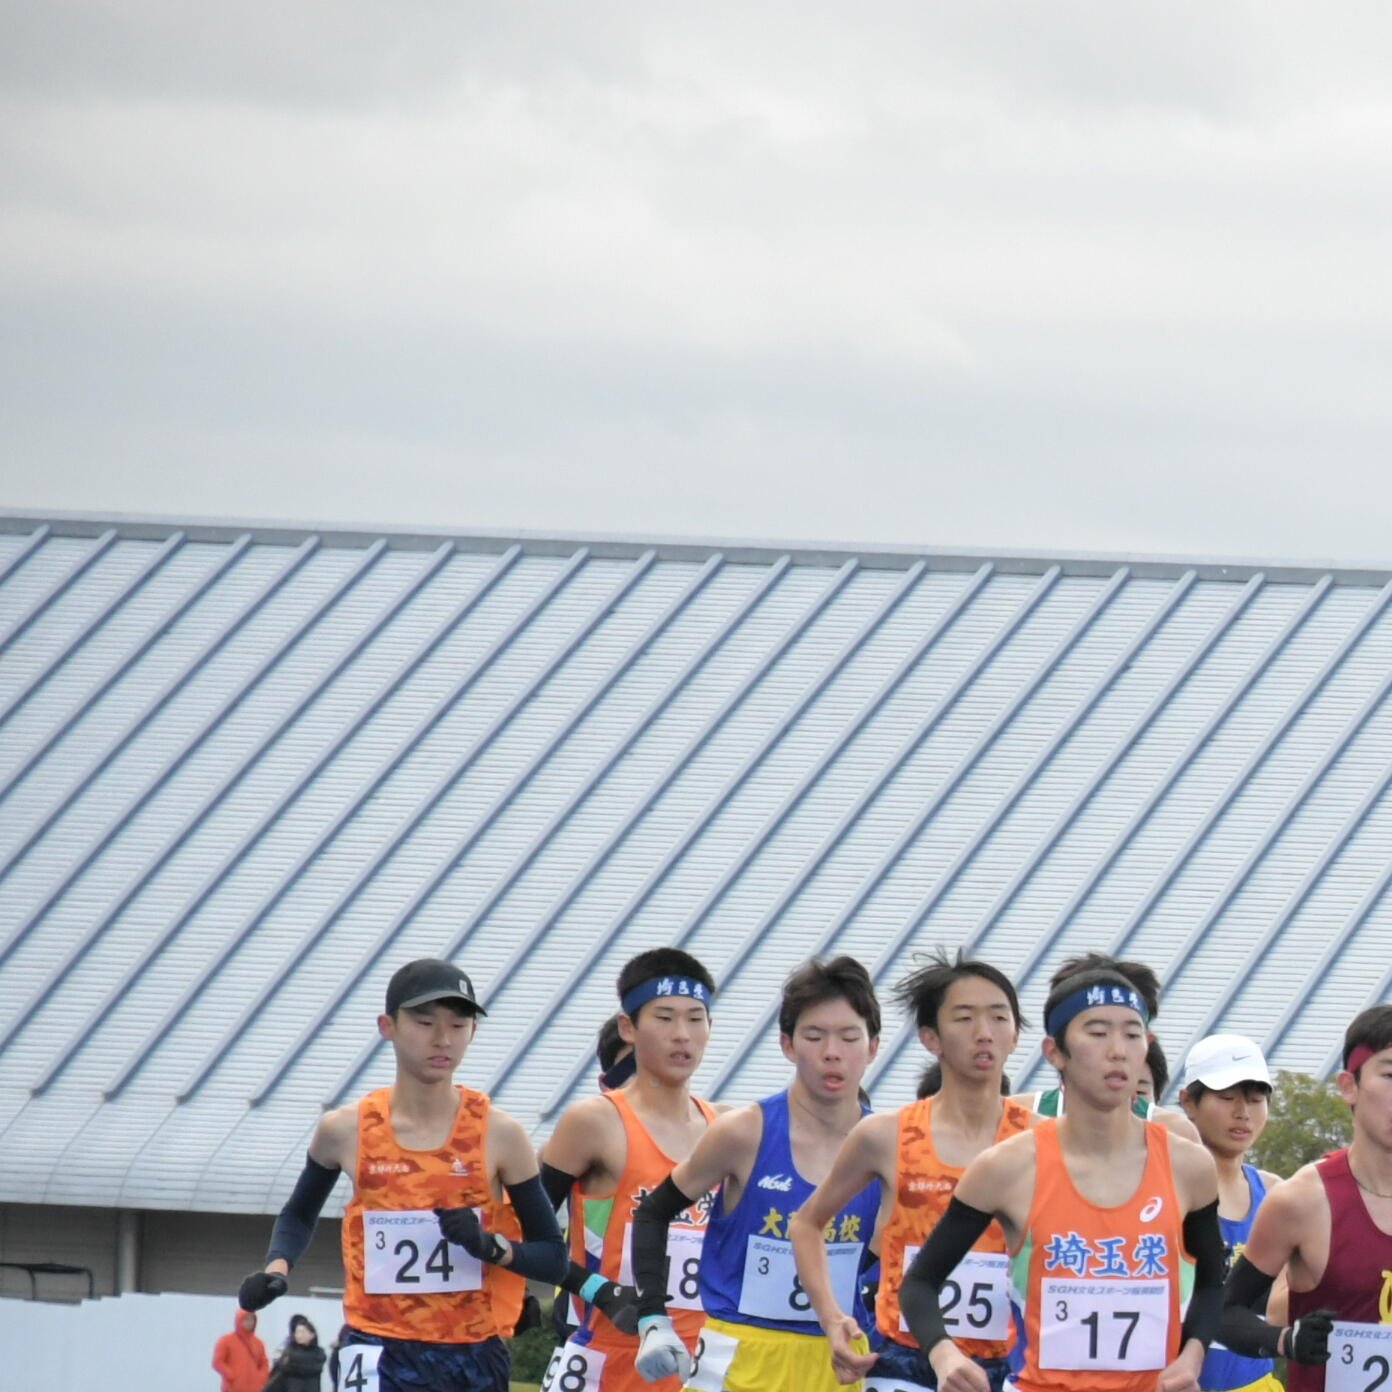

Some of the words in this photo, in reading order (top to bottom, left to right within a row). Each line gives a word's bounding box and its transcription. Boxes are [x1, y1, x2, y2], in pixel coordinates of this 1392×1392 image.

[375, 1231, 386, 1250] 3
[1043, 1231, 1169, 1277] 埼玉栄
[394, 1238, 454, 1284] 24
[757, 1257, 770, 1275] 3
[939, 1280, 994, 1329] 25
[1055, 1300, 1069, 1322] 3
[1080, 1311, 1141, 1360] 17
[1341, 1344, 1354, 1364] 3
